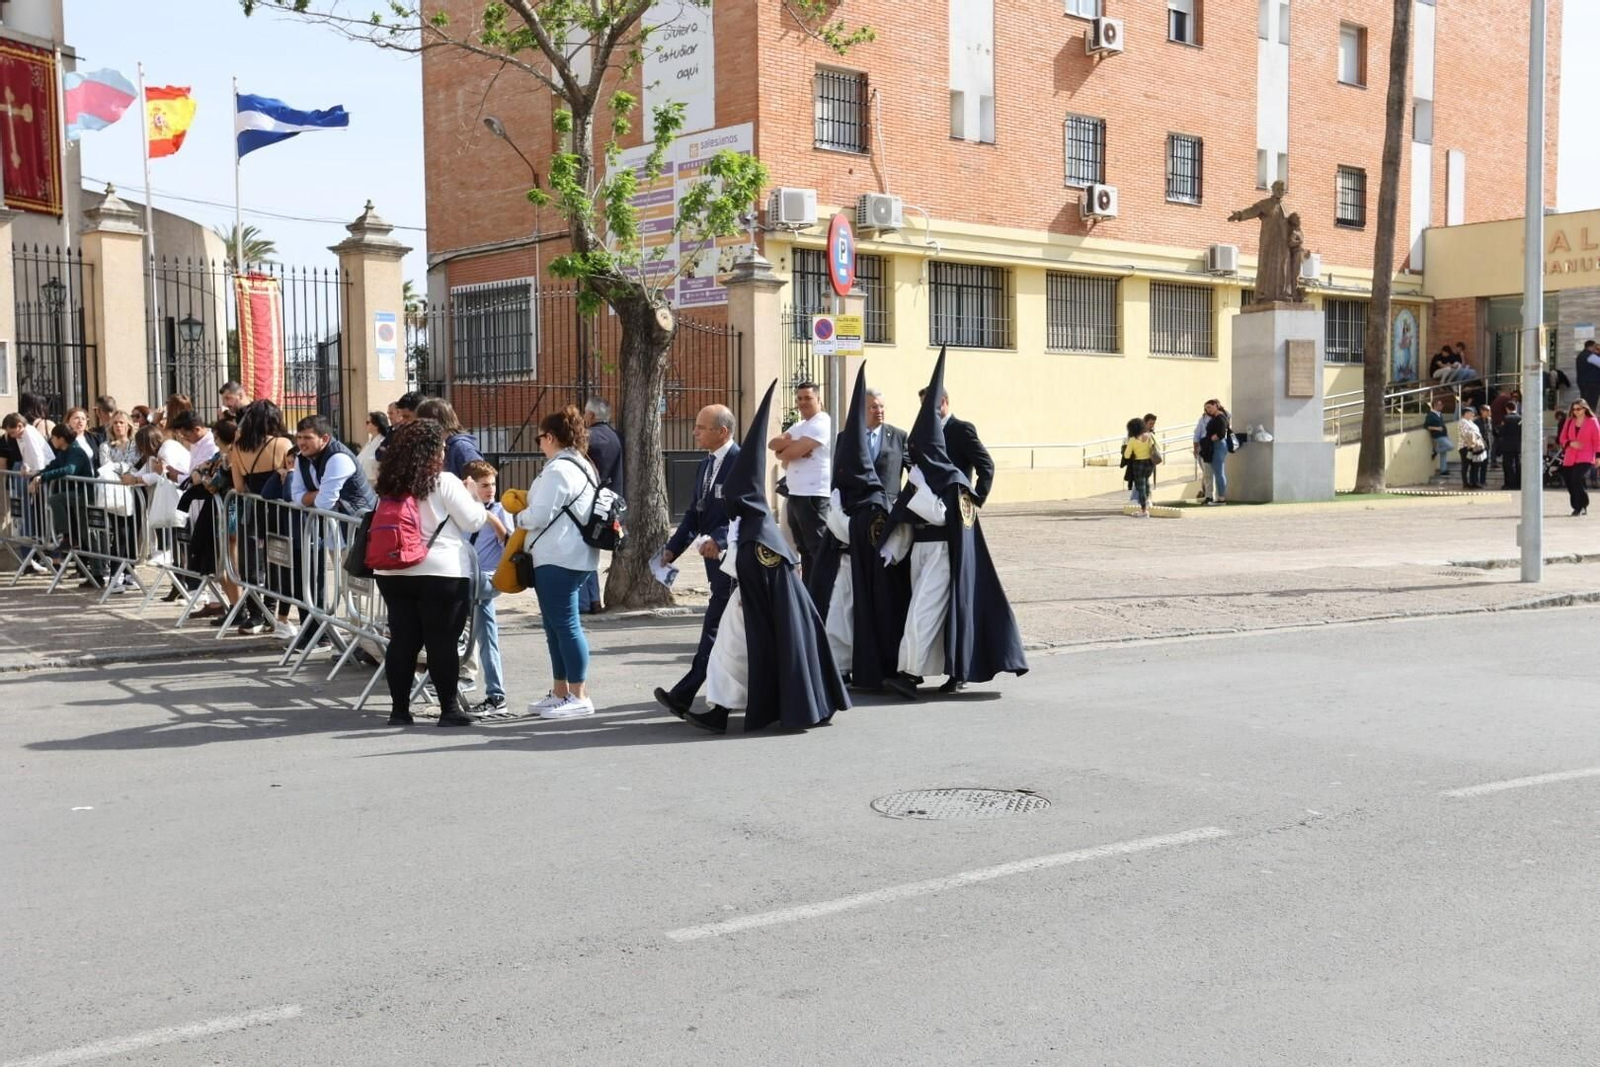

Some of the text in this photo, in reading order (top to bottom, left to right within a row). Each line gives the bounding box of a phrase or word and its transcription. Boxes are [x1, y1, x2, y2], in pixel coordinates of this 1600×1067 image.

[658, 43, 699, 63] estudiar
[700, 134, 739, 150] salesianos
[1520, 226, 1600, 255] AL
